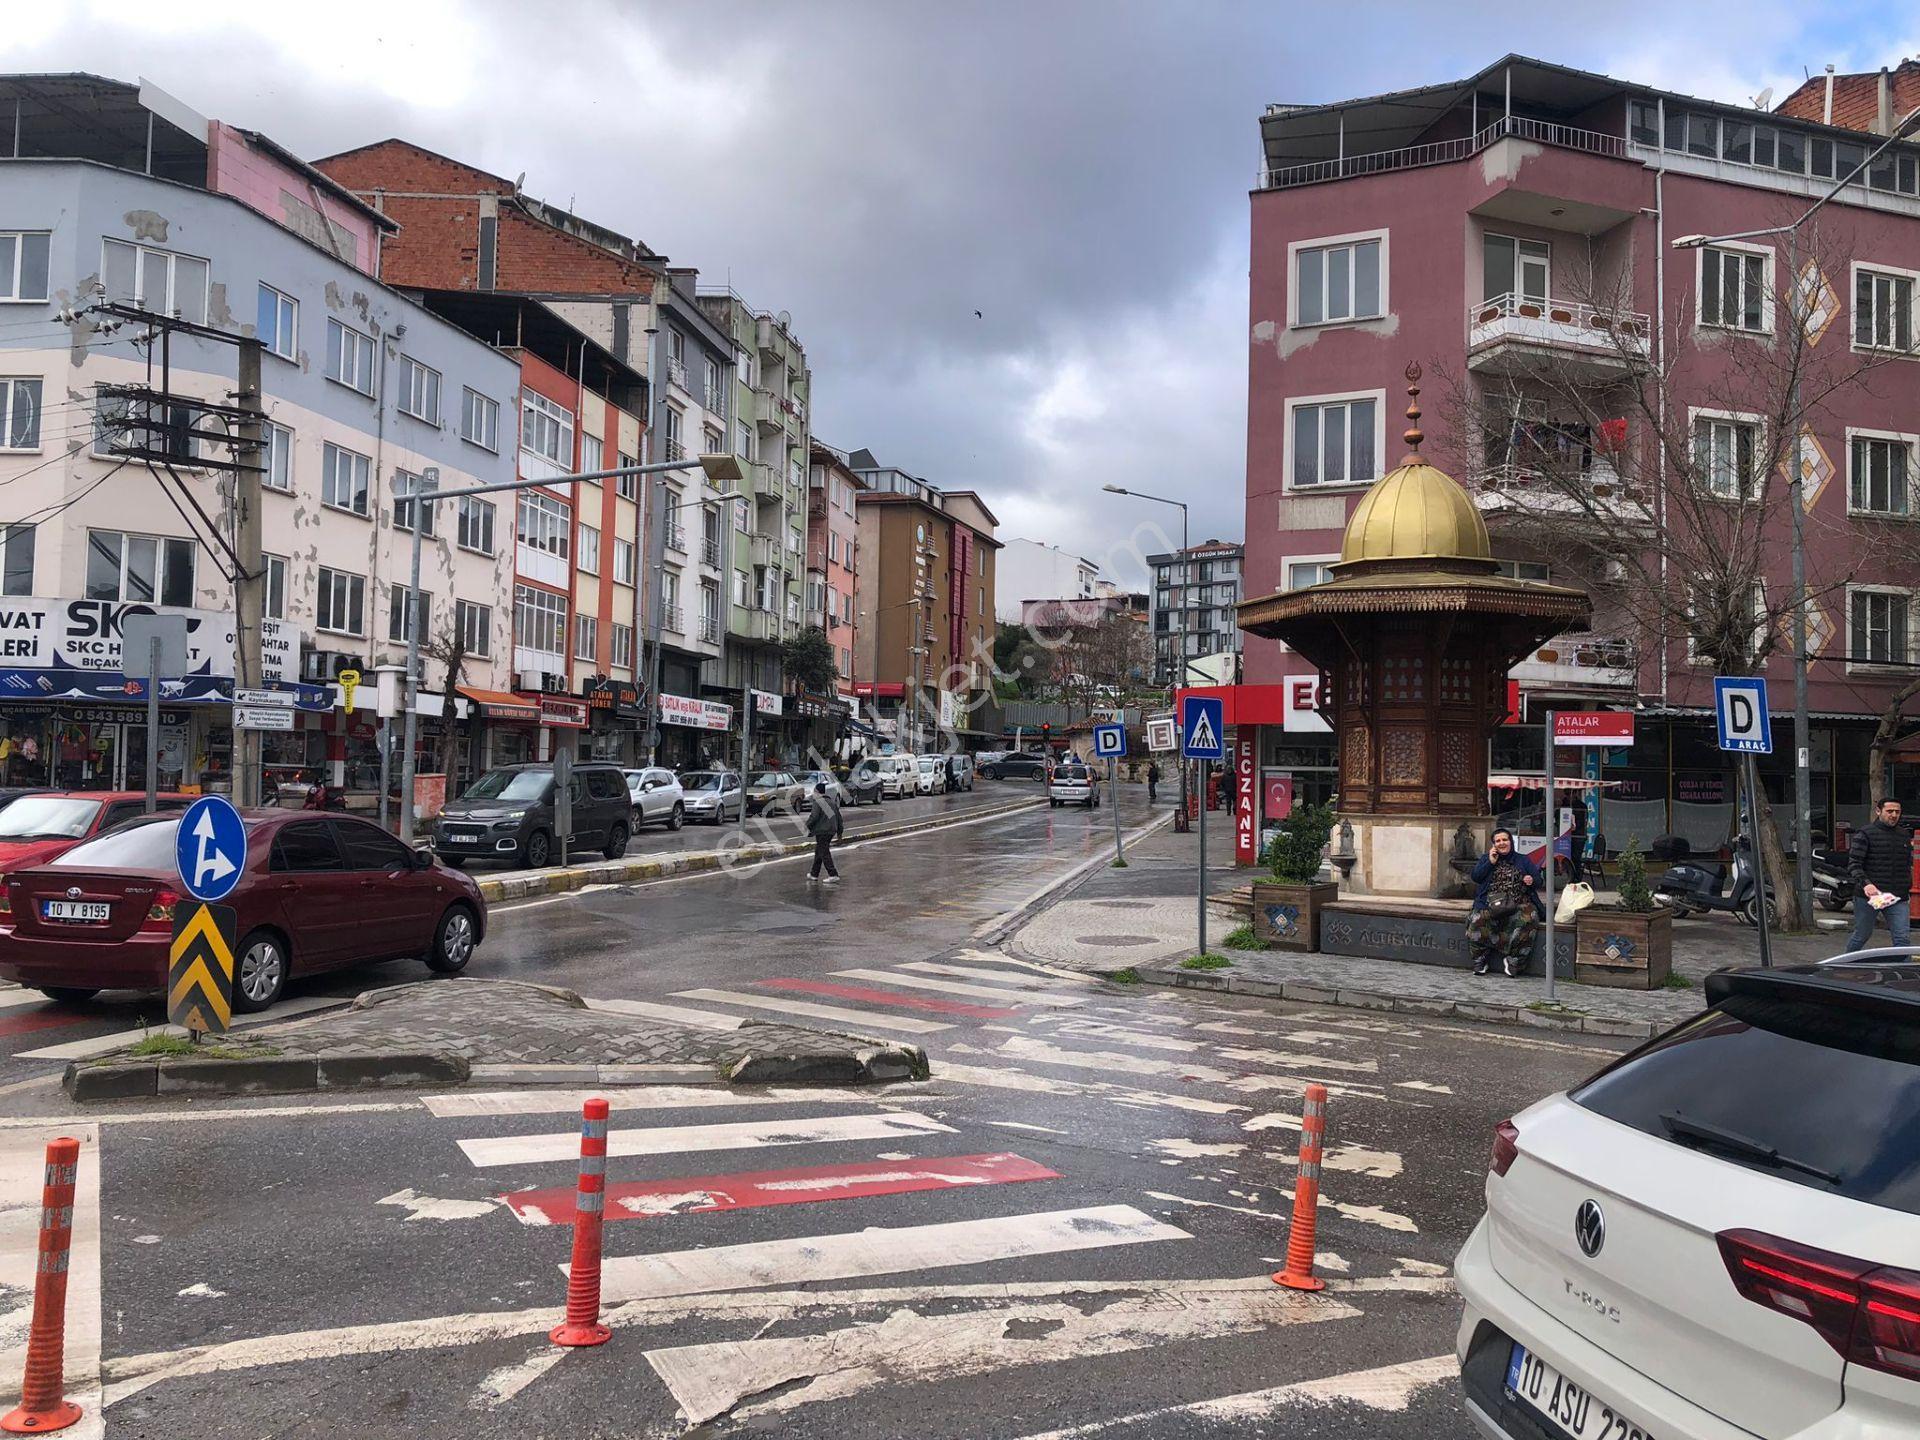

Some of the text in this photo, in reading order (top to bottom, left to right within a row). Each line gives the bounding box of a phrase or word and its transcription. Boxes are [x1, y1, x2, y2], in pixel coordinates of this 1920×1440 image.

[262, 621, 280, 636] EŞİT
[0, 635, 38, 657] ERİ
[66, 640, 104, 654] SKC
[262, 638, 289, 651] AHTAR
[1293, 682, 1320, 710] E
[74, 710, 83, 720] 0
[87, 710, 113, 721] 543
[117, 711, 142, 723] 589
[1558, 716, 1600, 727] ATALAR
[1730, 695, 1753, 733] D
[1103, 732, 1117, 749] D
[1154, 727, 1168, 746] E
[1725, 740, 1766, 751] 5 ARAÇ
[1240, 742, 1251, 848] ECZANE
[51, 903, 106, 918] 10 V 8195
[1564, 1278, 1621, 1324] T-ROC
[1520, 1354, 1544, 1400] 10
[1549, 1374, 1590, 1436] ASU
